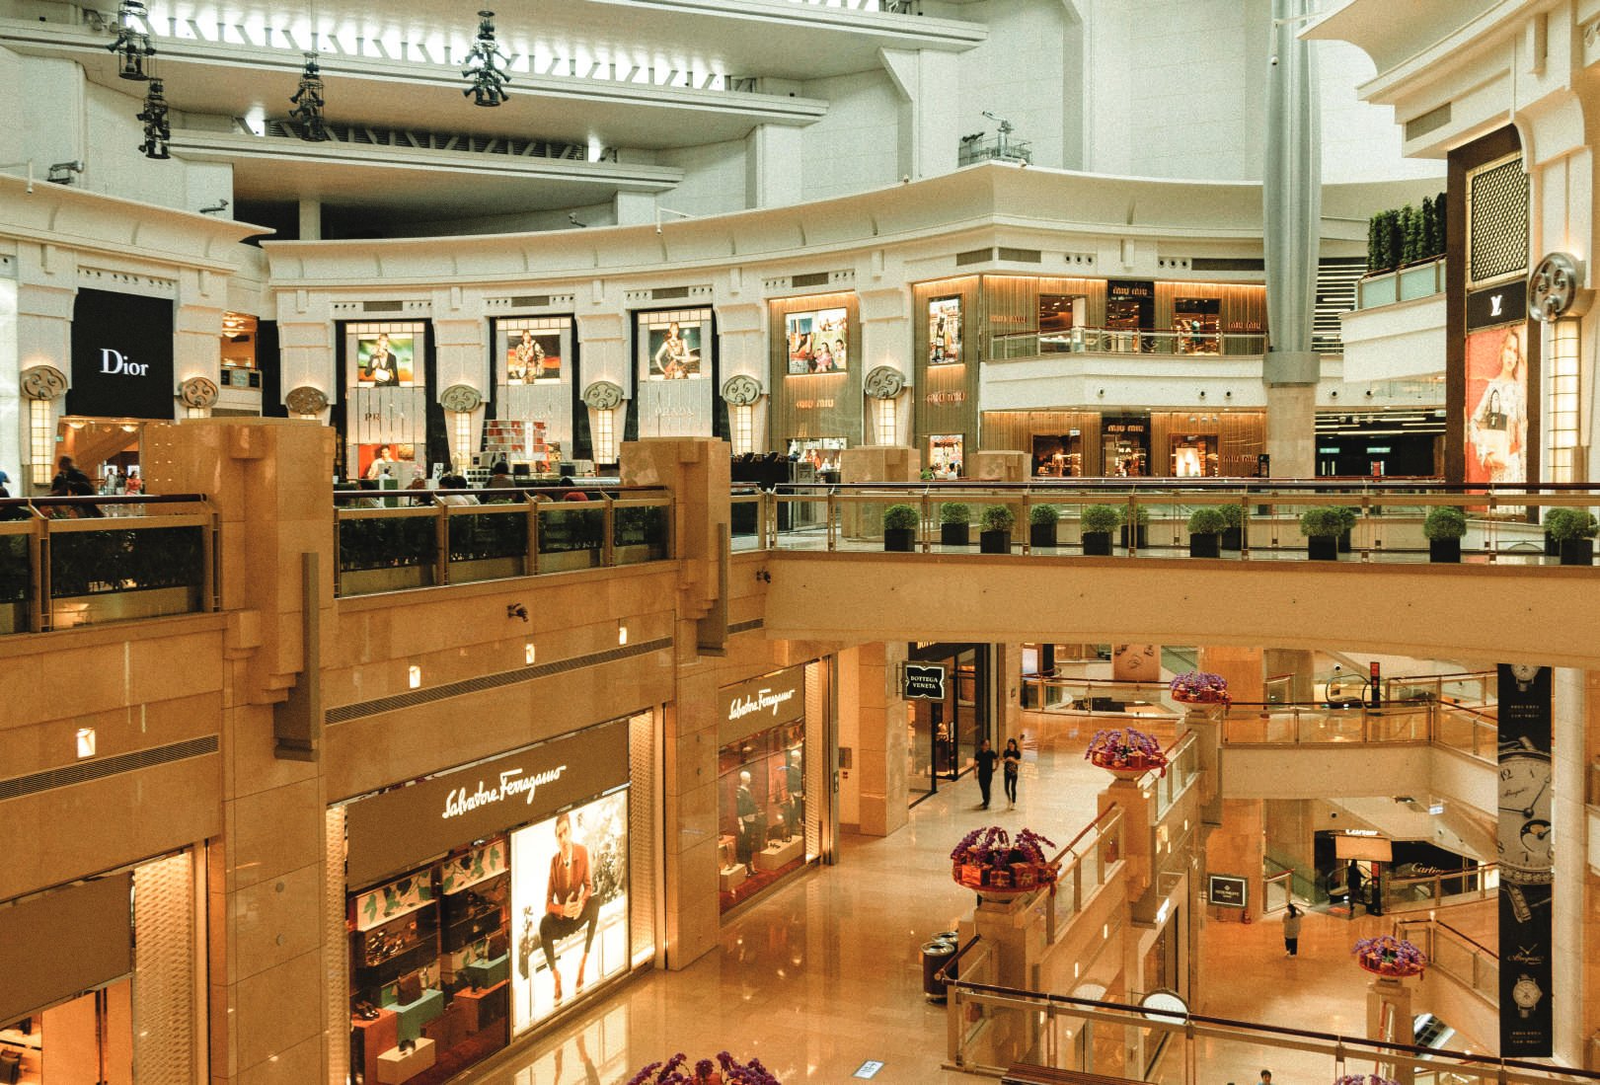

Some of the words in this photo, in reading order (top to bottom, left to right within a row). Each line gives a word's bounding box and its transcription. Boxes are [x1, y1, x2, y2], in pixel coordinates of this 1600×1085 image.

[99, 347, 150, 377] Dior
[910, 675, 938, 683] BOTTEGA
[912, 682, 936, 690] VENETA
[442, 781, 500, 819] Salvatore
[499, 765, 567, 805] Ferragamo
